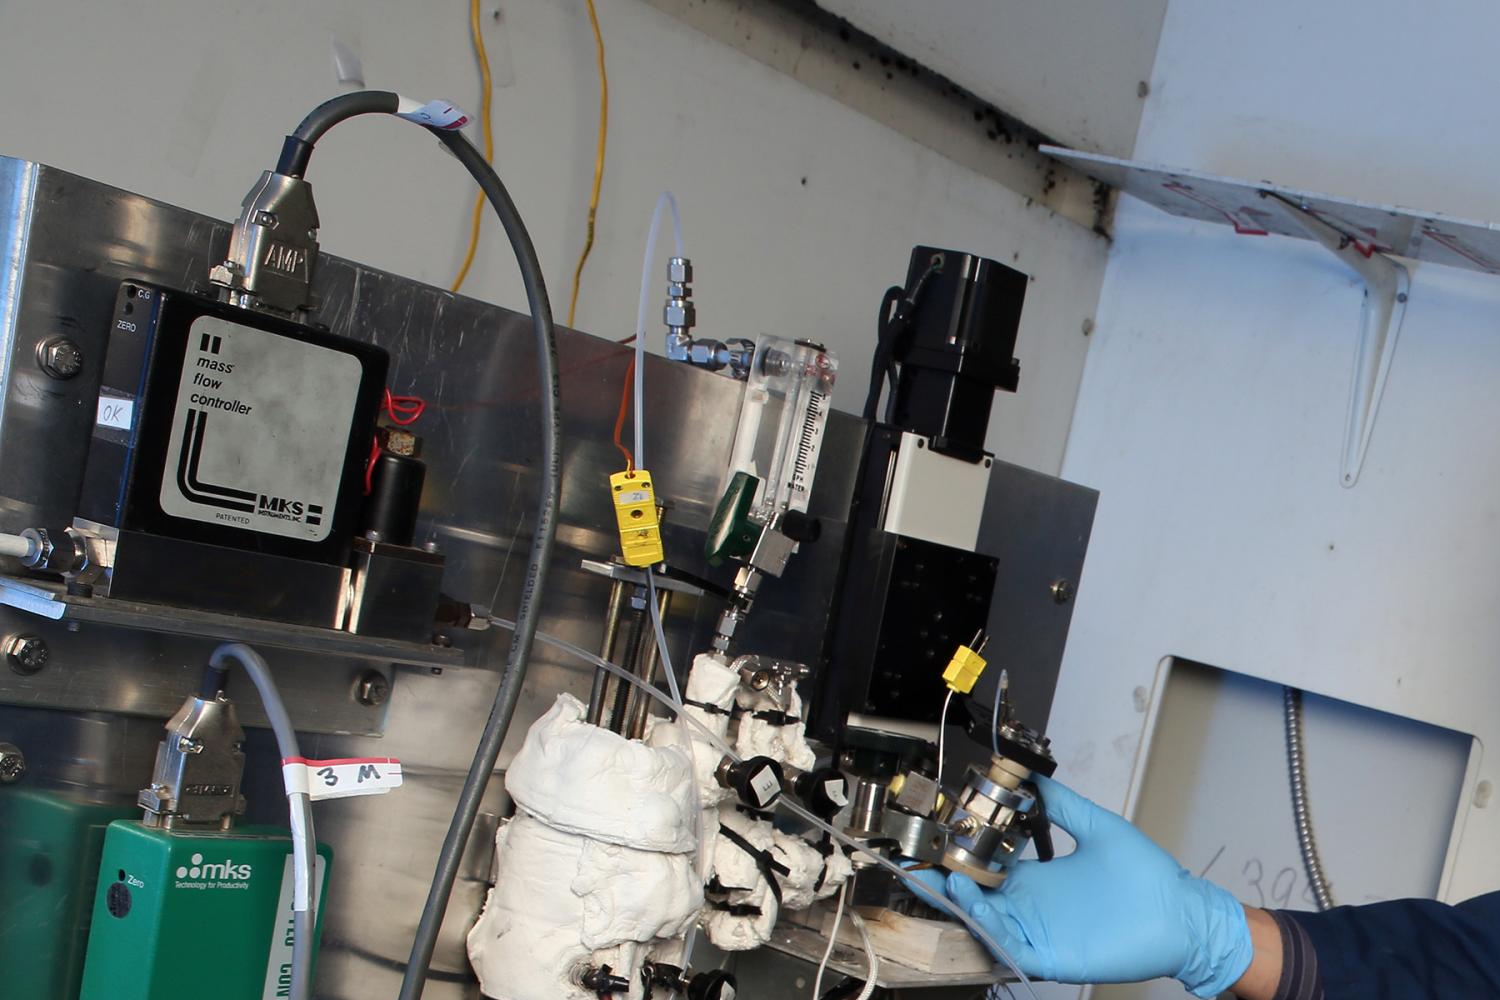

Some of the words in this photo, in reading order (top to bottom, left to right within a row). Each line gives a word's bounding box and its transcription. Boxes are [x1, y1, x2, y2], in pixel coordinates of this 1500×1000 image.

[116, 319, 137, 333] ZERO
[197, 357, 234, 374] mass
[193, 372, 223, 390] flow
[103, 404, 123, 422] OK
[190, 393, 253, 415] controller
[259, 494, 304, 516] MKS
[215, 512, 250, 525] PATENTED
[316, 766, 339, 787] 3
[201, 859, 252, 880] mks
[128, 874, 145, 889] Zero
[175, 881, 207, 890] Technology
[216, 881, 249, 890] Productivity
